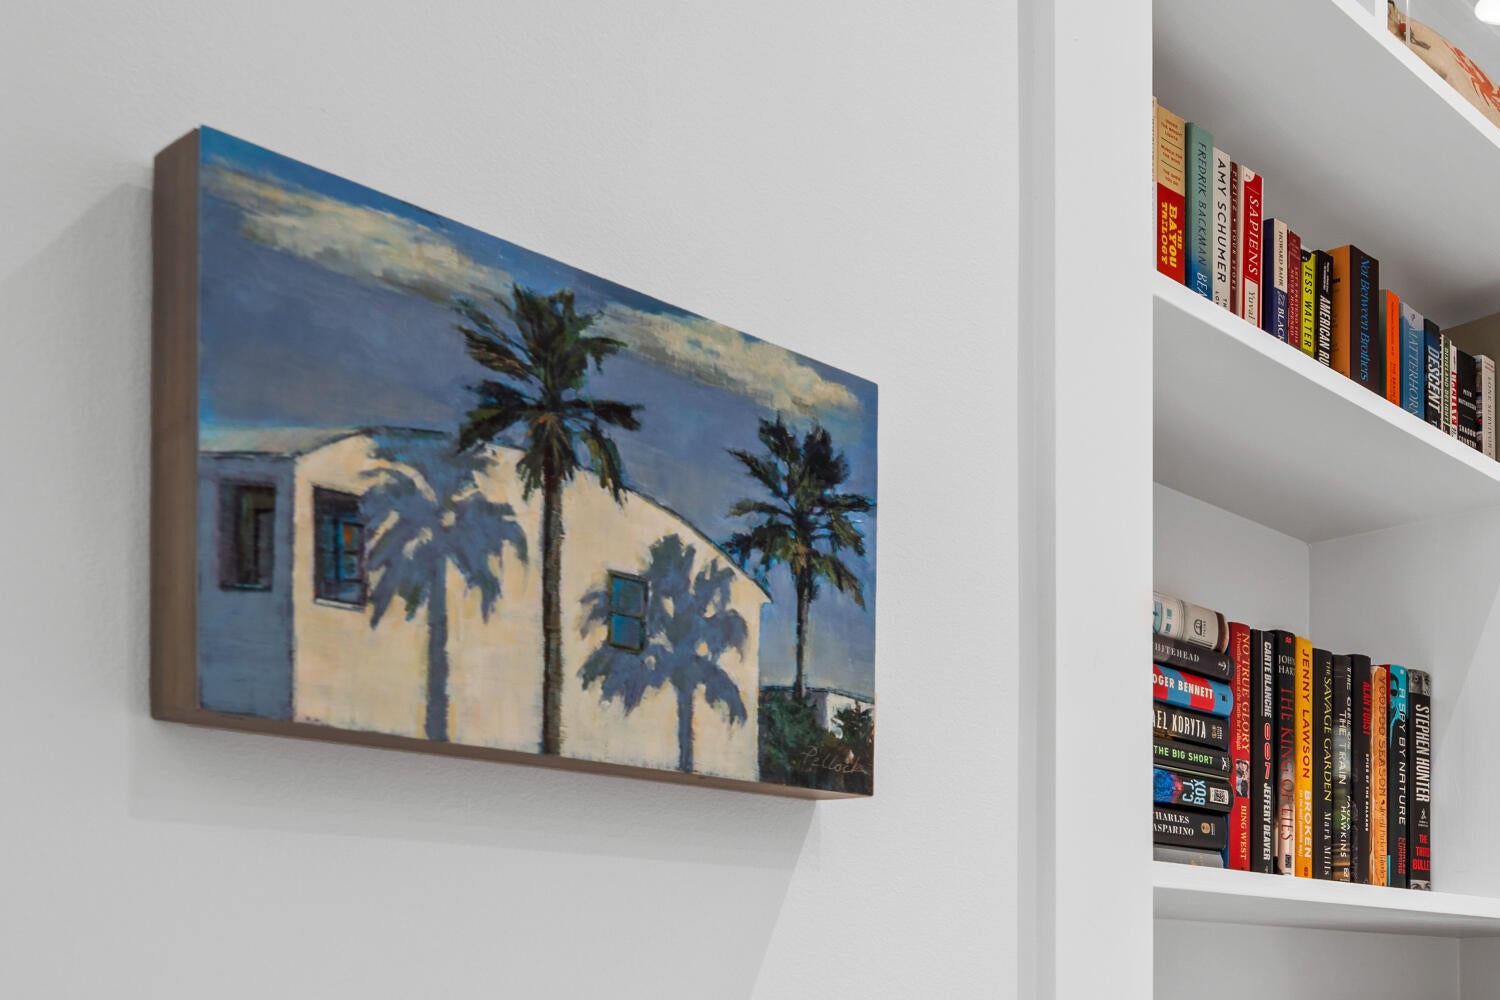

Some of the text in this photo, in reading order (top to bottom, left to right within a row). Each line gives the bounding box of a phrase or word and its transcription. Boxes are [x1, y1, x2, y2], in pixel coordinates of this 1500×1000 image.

[1168, 202, 1178, 268] BAYOU
[1198, 200, 1206, 266] BACKMAN
[1216, 158, 1227, 284] AMY SCHUMER
[1248, 195, 1260, 276] SAPIENS
[1304, 265, 1312, 348] JESS WALTER
[1319, 294, 1332, 348] AMERICAN
[1360, 280, 1370, 331] Between
[1360, 332, 1370, 381] Brothers
[1427, 345, 1440, 414] DESCENT
[1153, 642, 1200, 663] HITEHEAD
[1264, 642, 1272, 672] CARTE
[1177, 681, 1214, 700] BENNETT
[1241, 632, 1250, 754] NO TRUE GLORY
[1264, 673, 1272, 718] BLANCHE
[1281, 688, 1293, 720] THE
[1302, 648, 1310, 779] JENNY LAWSON
[1172, 713, 1206, 740] KORYTA
[1280, 727, 1294, 773] KING
[1323, 676, 1332, 802] SAVAGE GARDEN
[1338, 712, 1346, 785] THE TRAIN
[1398, 736, 1406, 760] BY
[1154, 744, 1214, 766] THE BIG SHORT
[1415, 704, 1430, 803] STEPHEN HUNTER
[1193, 778, 1207, 806] BOX
[1263, 782, 1271, 824] JEFFERY
[1153, 811, 1190, 826] HARLES
[1153, 823, 1195, 838] ASPARINO
[1263, 824, 1271, 861] DEAVER
[1280, 808, 1294, 841] LIES
[1304, 790, 1312, 858] BROKEN
[1324, 810, 1332, 876] Mark Mills
[1340, 806, 1348, 858] HAWKINS
[1419, 834, 1428, 845] THE
